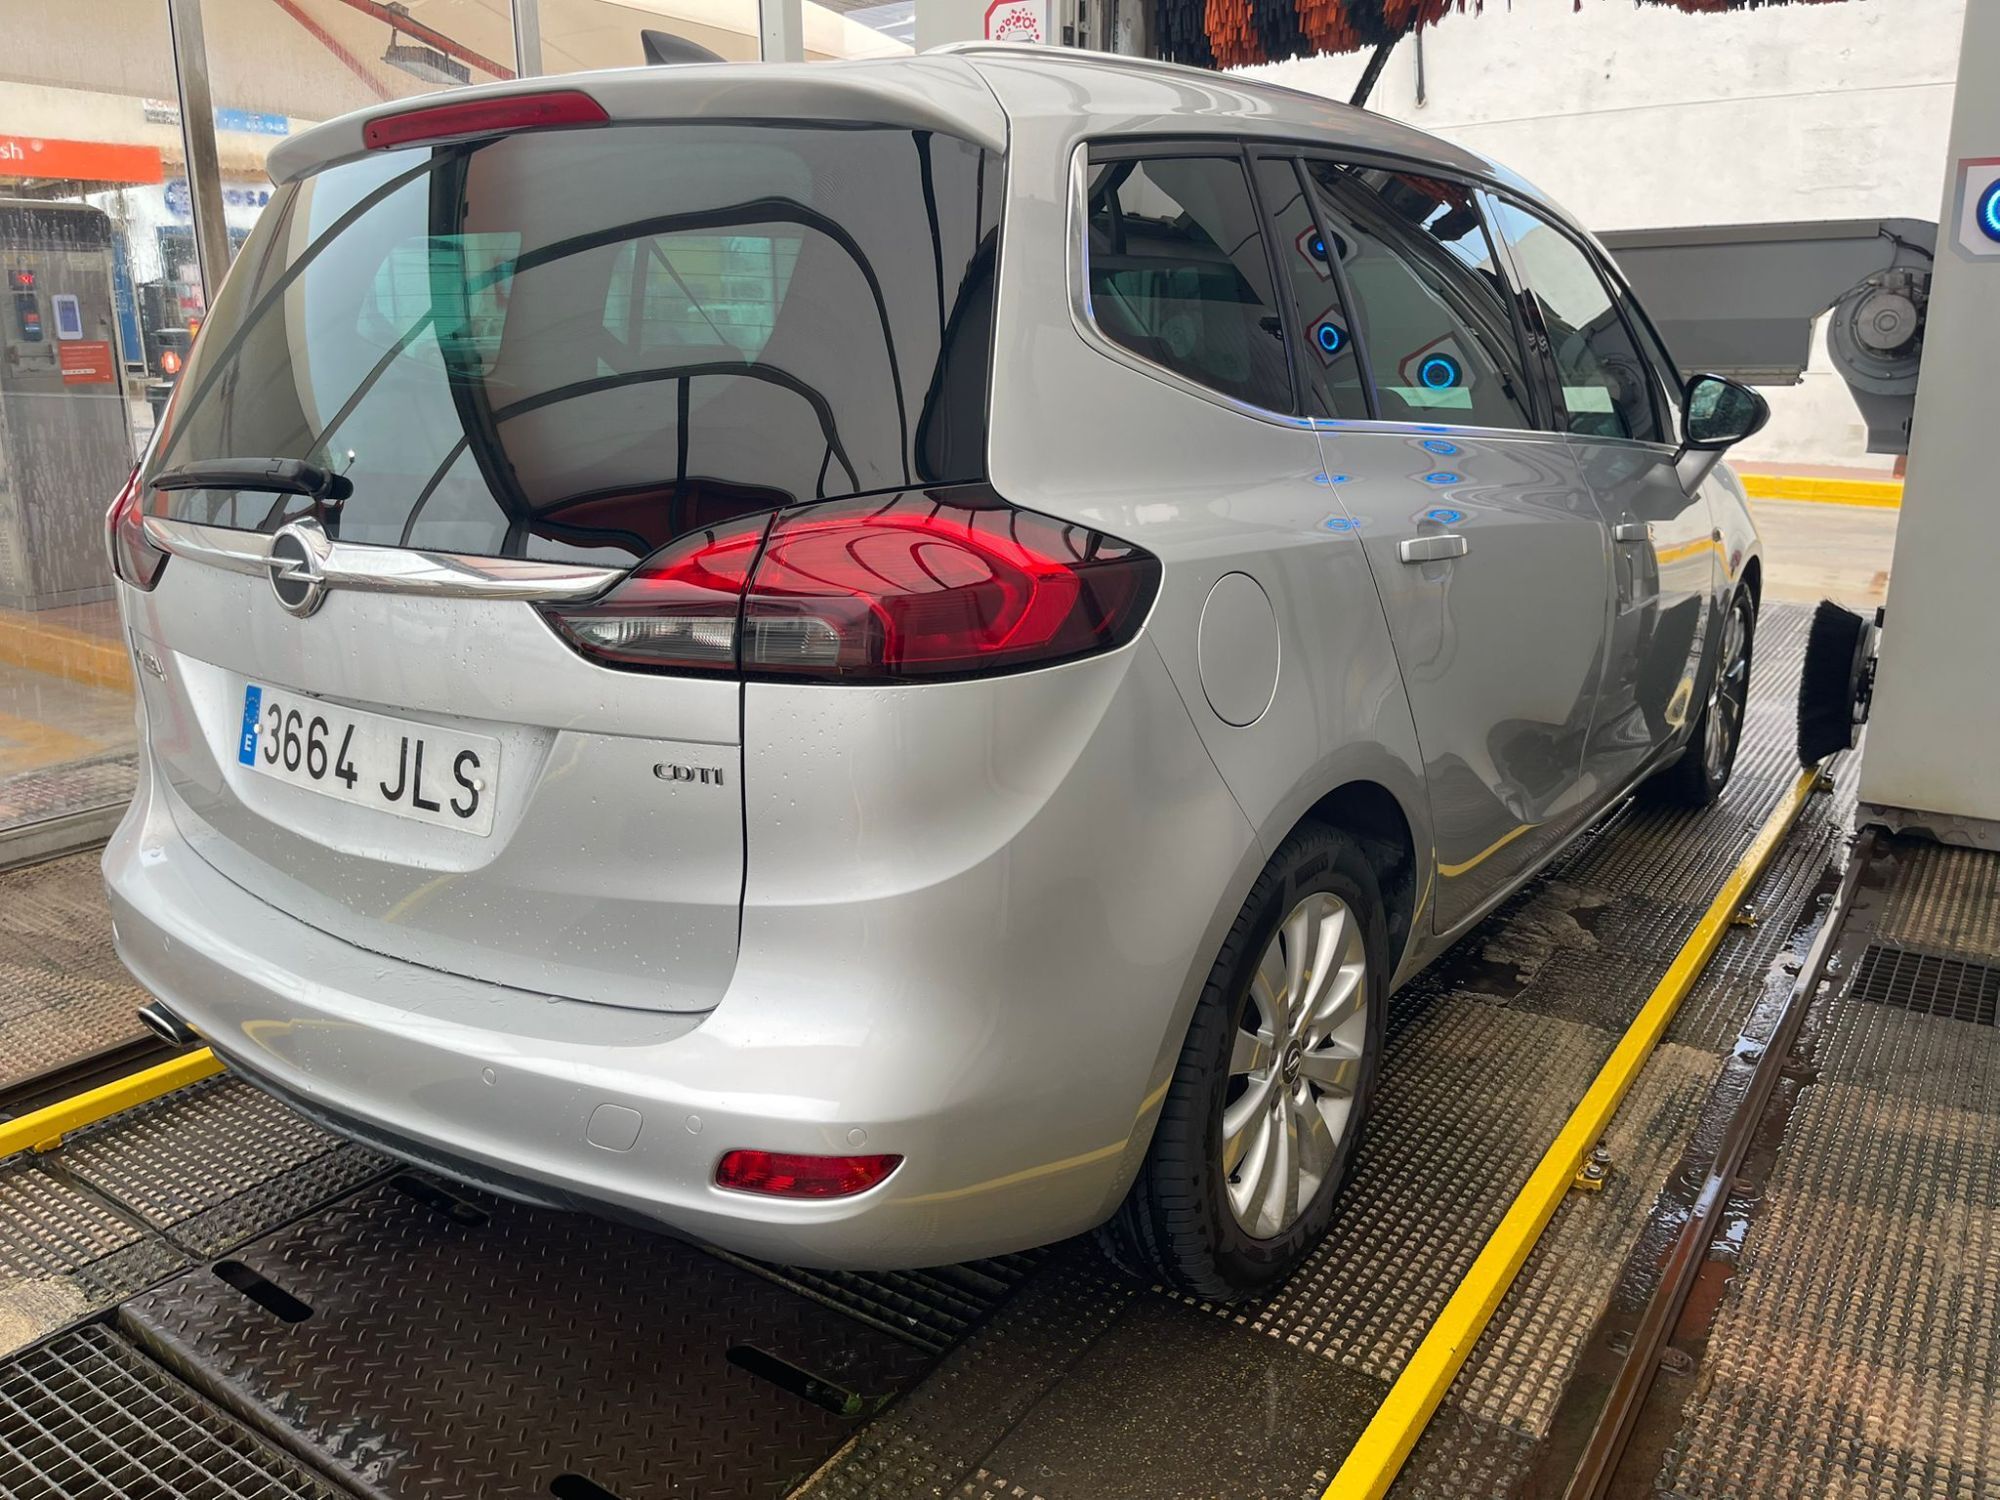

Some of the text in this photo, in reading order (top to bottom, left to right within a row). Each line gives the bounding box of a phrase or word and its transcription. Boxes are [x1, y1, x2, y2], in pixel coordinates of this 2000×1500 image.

[244, 733, 253, 752] E
[264, 703, 480, 818] 3664 JLS
[653, 763, 723, 785] CDTI
